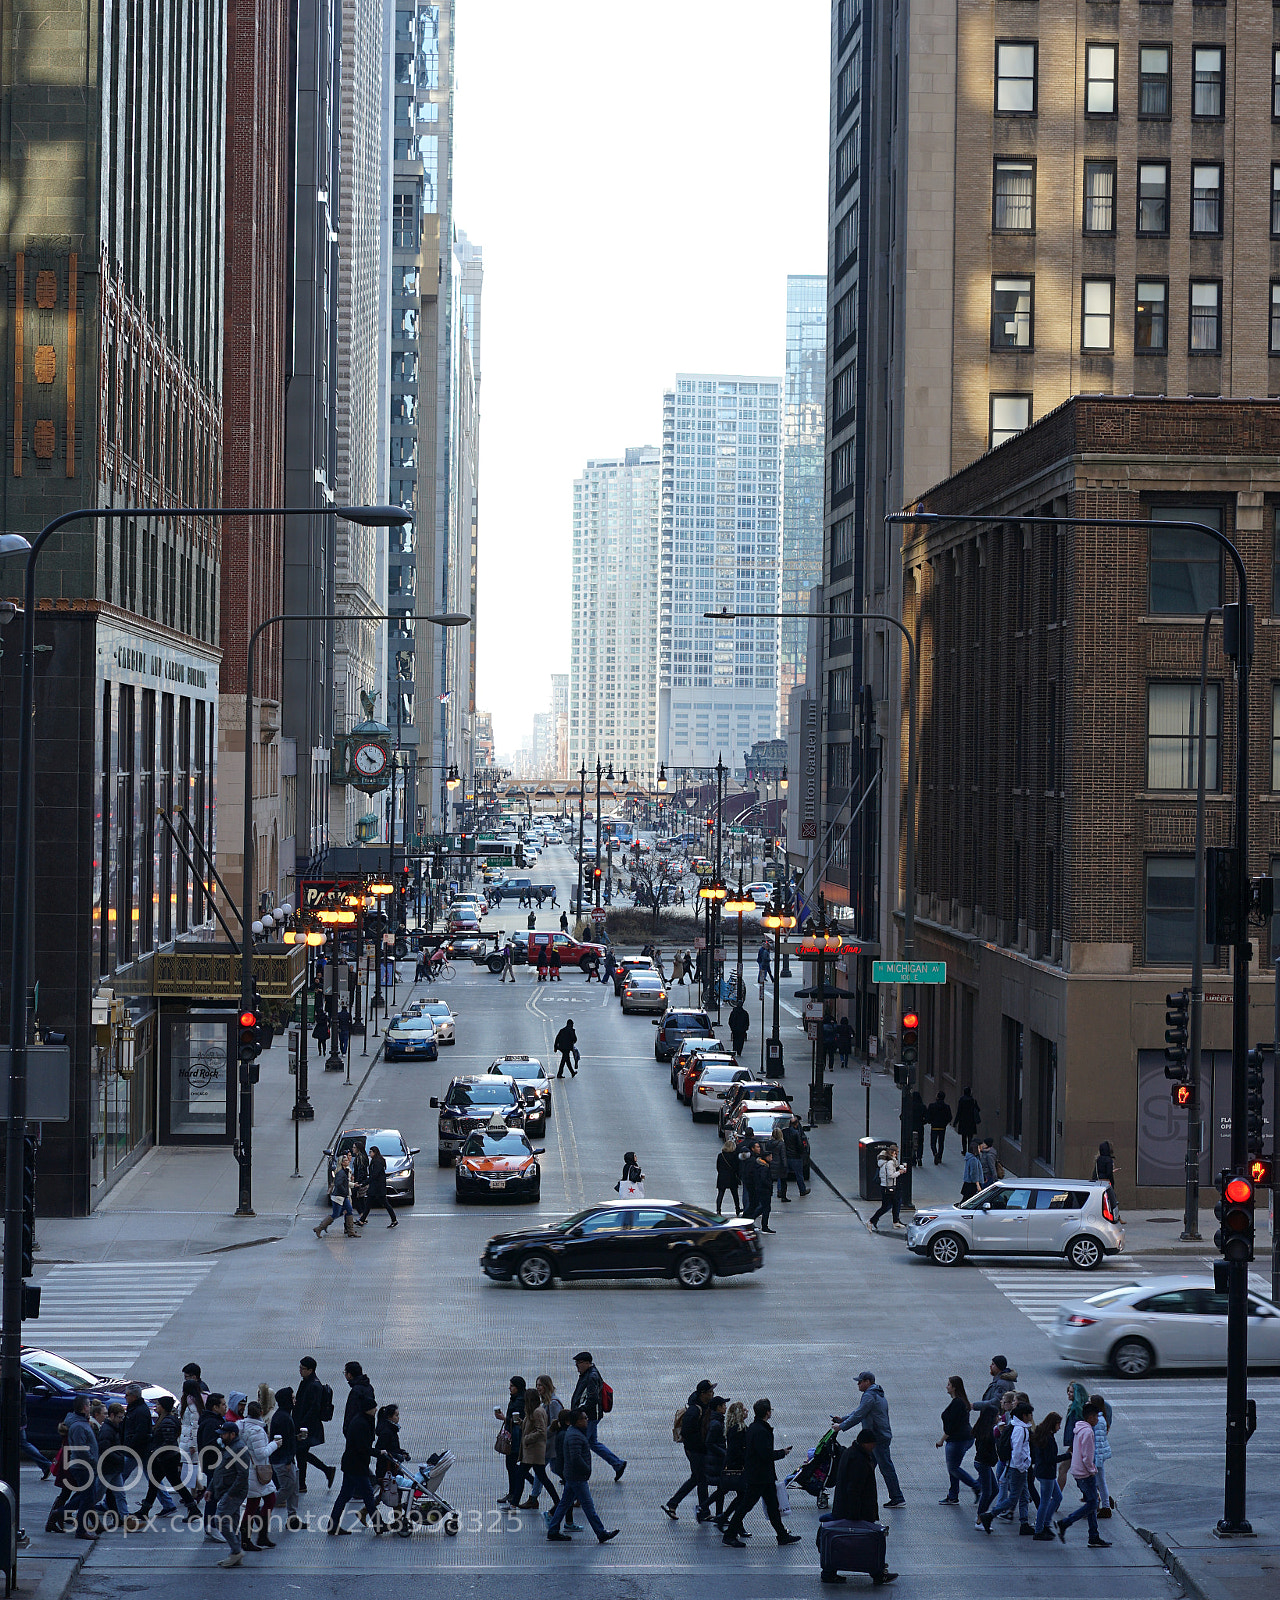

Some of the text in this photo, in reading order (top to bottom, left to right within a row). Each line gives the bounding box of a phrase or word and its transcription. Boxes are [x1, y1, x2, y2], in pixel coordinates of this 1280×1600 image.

[118, 645, 146, 674] CARBIDE
[151, 655, 162, 678] AND
[165, 660, 185, 683] CARBON
[804, 703, 817, 821] Hilton Garden Inn
[841, 944, 861, 955] Inn
[886, 964, 928, 973] MICHIGAN
[179, 1069, 219, 1079] Hard Rock
